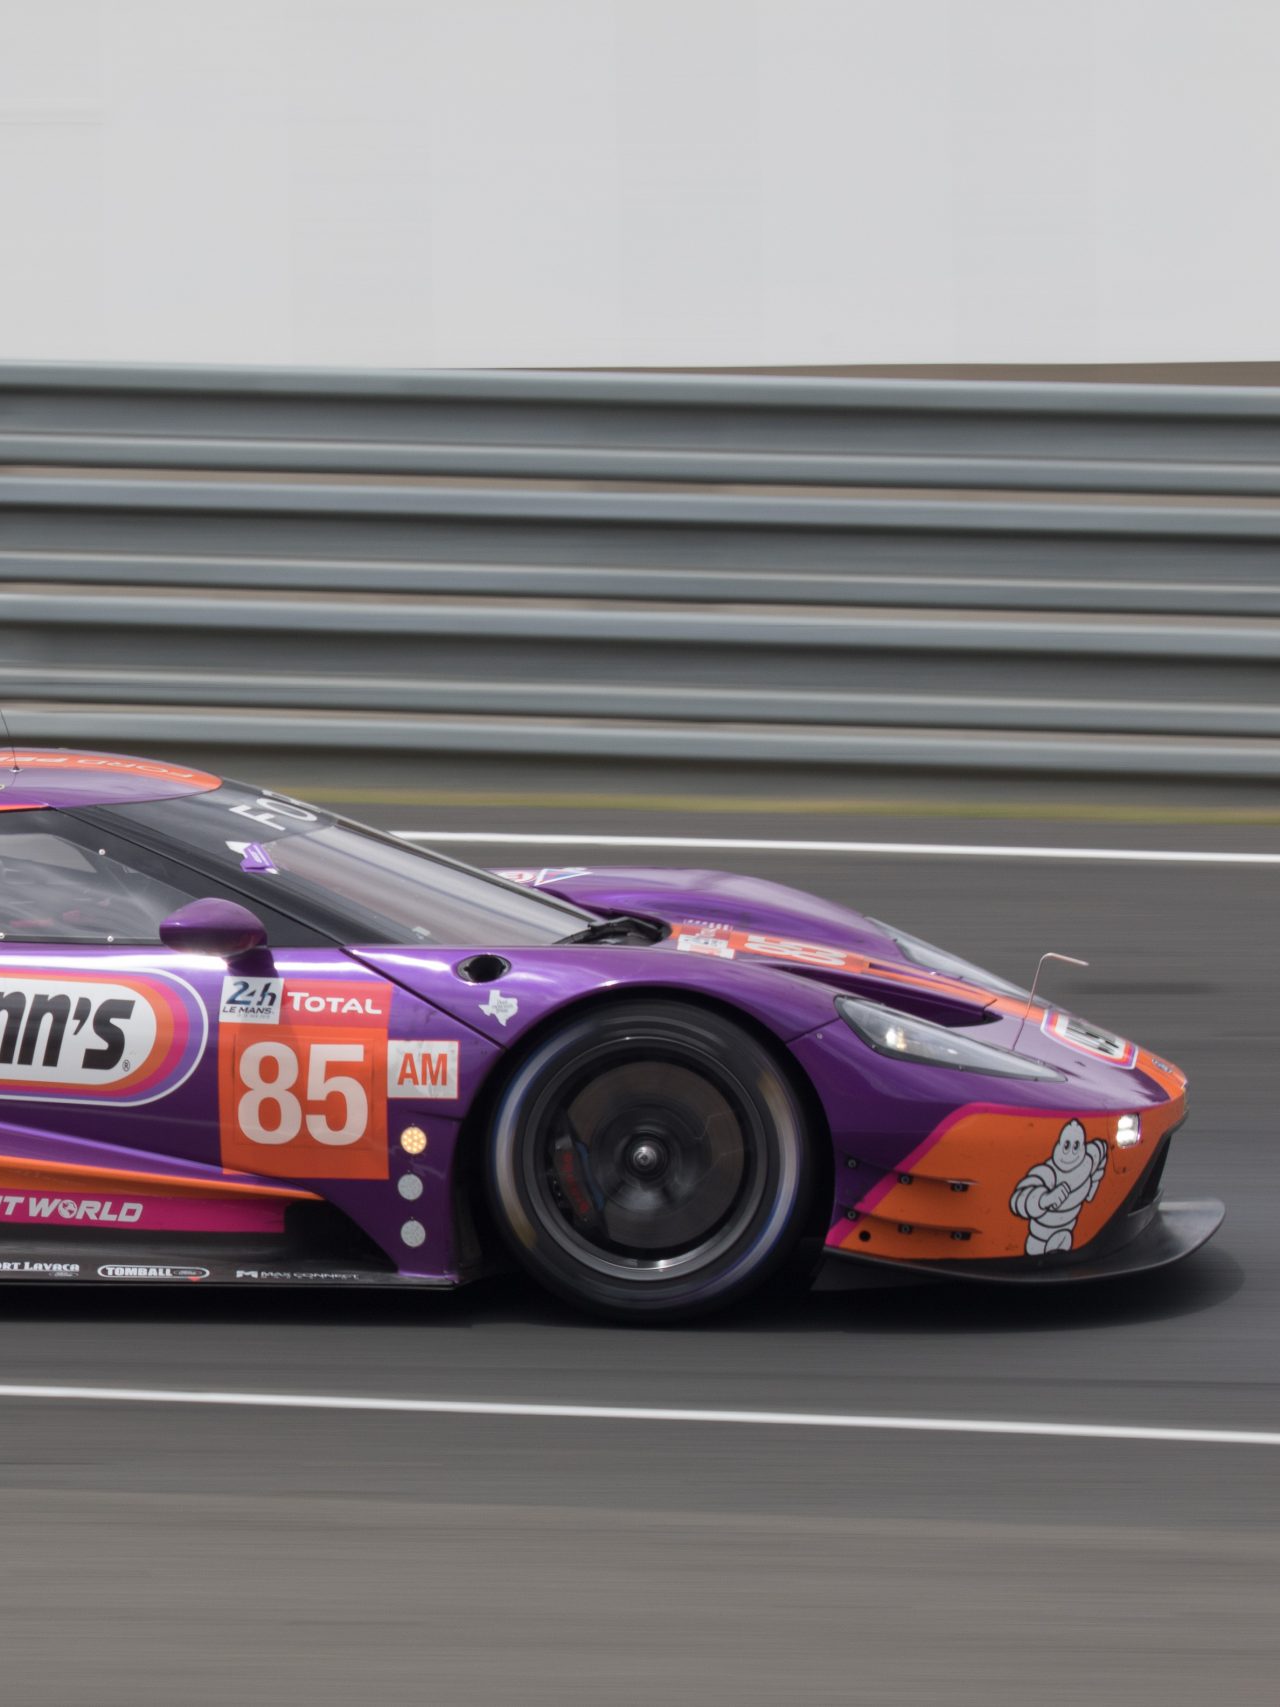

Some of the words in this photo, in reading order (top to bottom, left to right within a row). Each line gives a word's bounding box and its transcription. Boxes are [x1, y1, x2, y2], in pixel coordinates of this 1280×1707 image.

[222, 1006, 237, 1014] LE
[239, 1006, 272, 1015] MANS
[287, 991, 383, 1015] TOTAL
[397, 1053, 448, 1086] AM
[237, 1041, 369, 1146] 85
[28, 1197, 144, 1223] WORLD
[105, 1267, 173, 1277] TOMBALL
